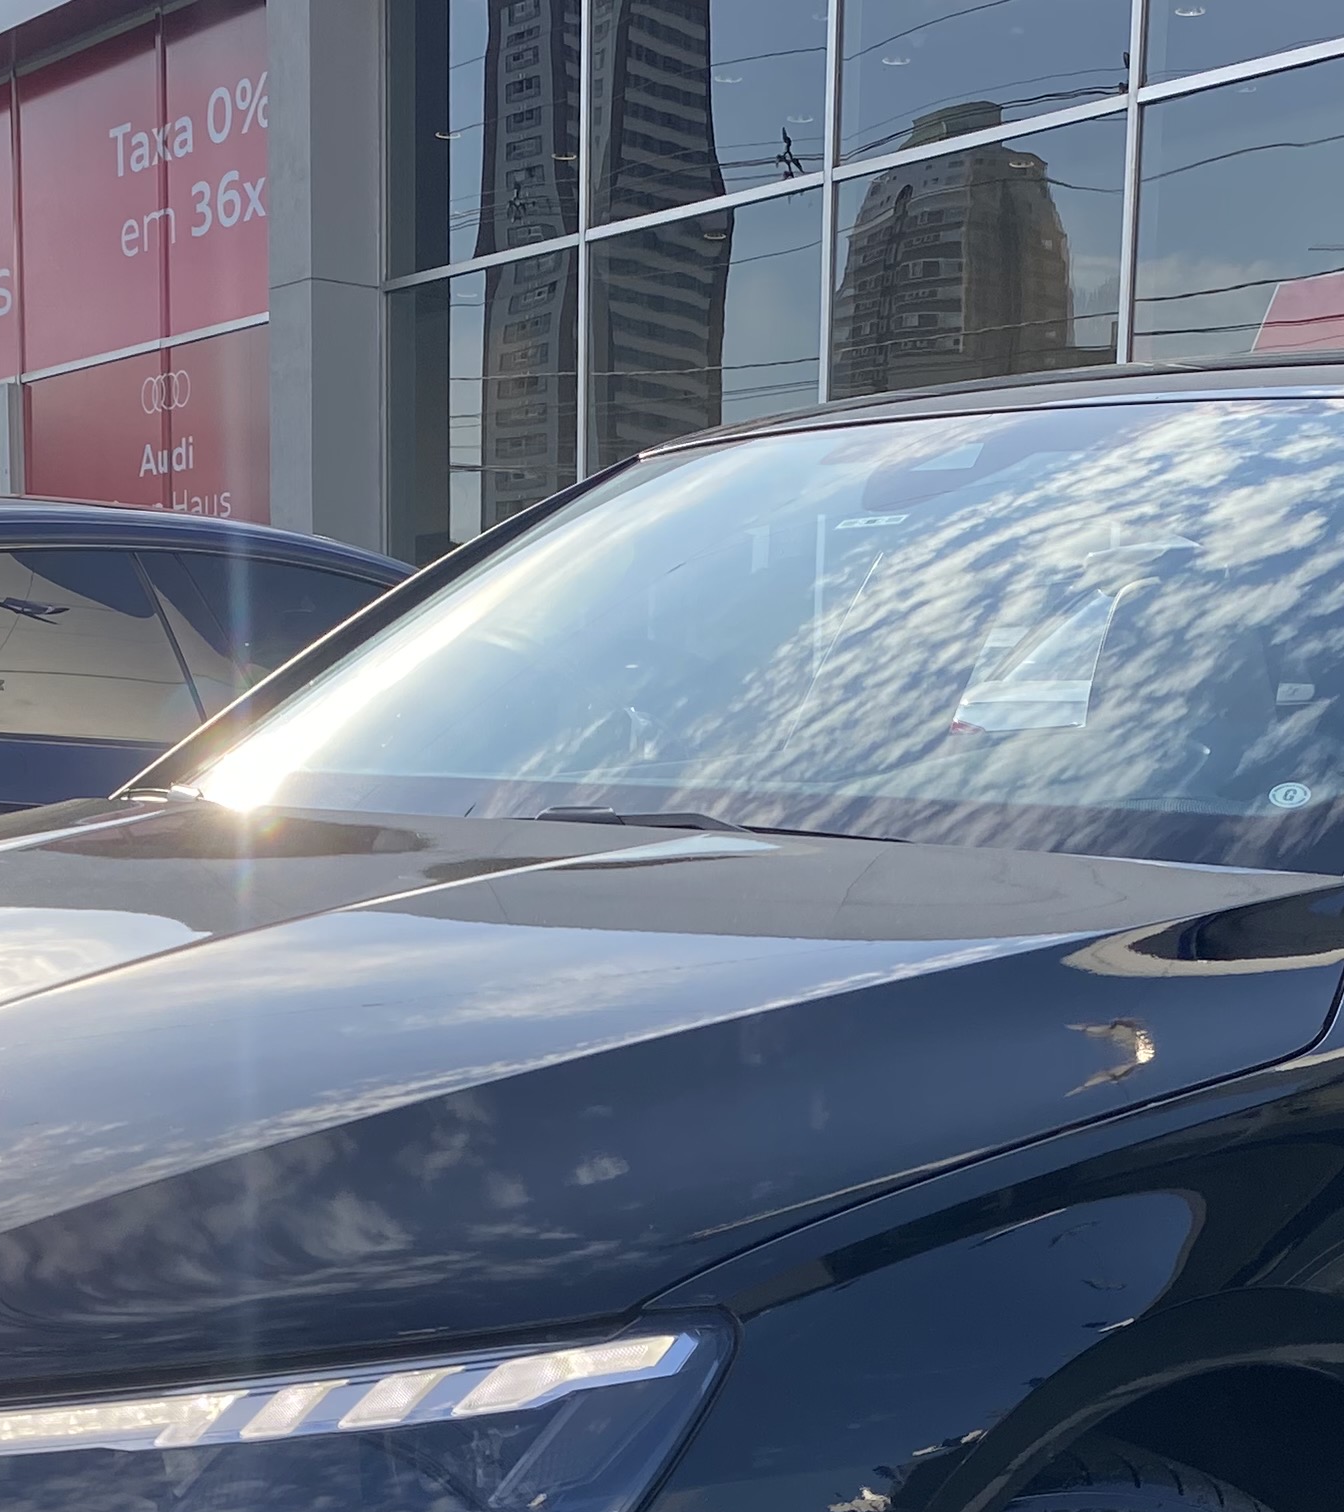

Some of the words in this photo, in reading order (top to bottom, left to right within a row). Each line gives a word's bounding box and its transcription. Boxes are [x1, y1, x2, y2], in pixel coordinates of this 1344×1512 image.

[109, 122, 194, 177] Taxa
[207, 71, 269, 144] 0%
[191, 170, 267, 238] 36x
[139, 435, 194, 478] Audi
